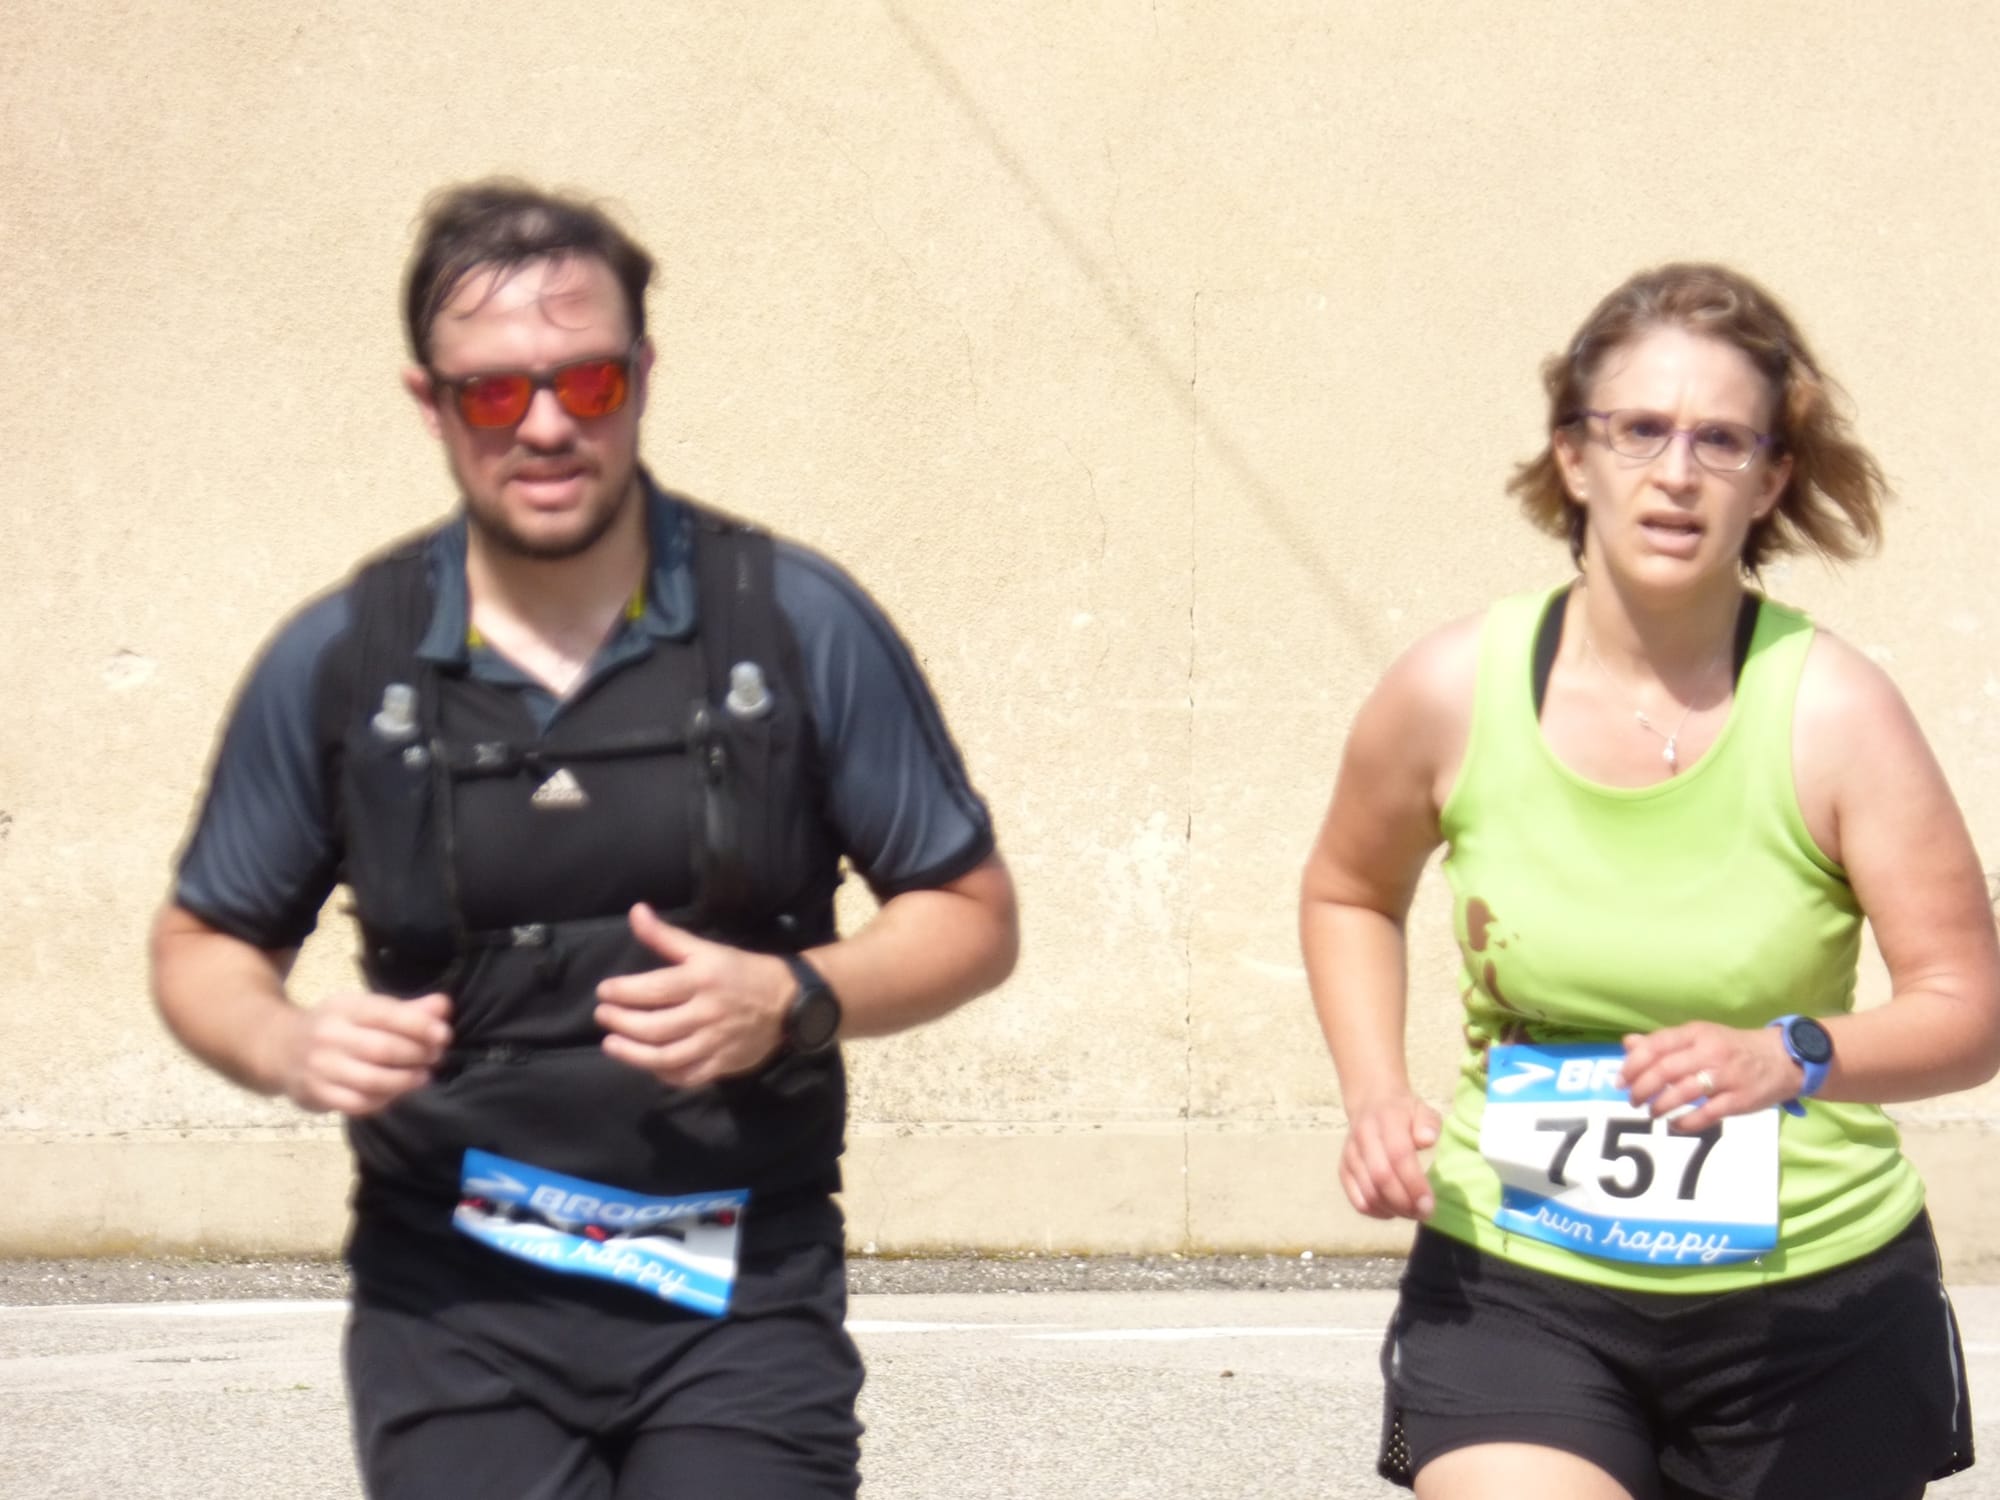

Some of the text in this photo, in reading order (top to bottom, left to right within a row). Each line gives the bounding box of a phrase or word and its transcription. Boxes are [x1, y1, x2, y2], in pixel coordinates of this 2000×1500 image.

[1535, 1117, 1723, 1200] 757
[1534, 1206, 1730, 1263] run happy
